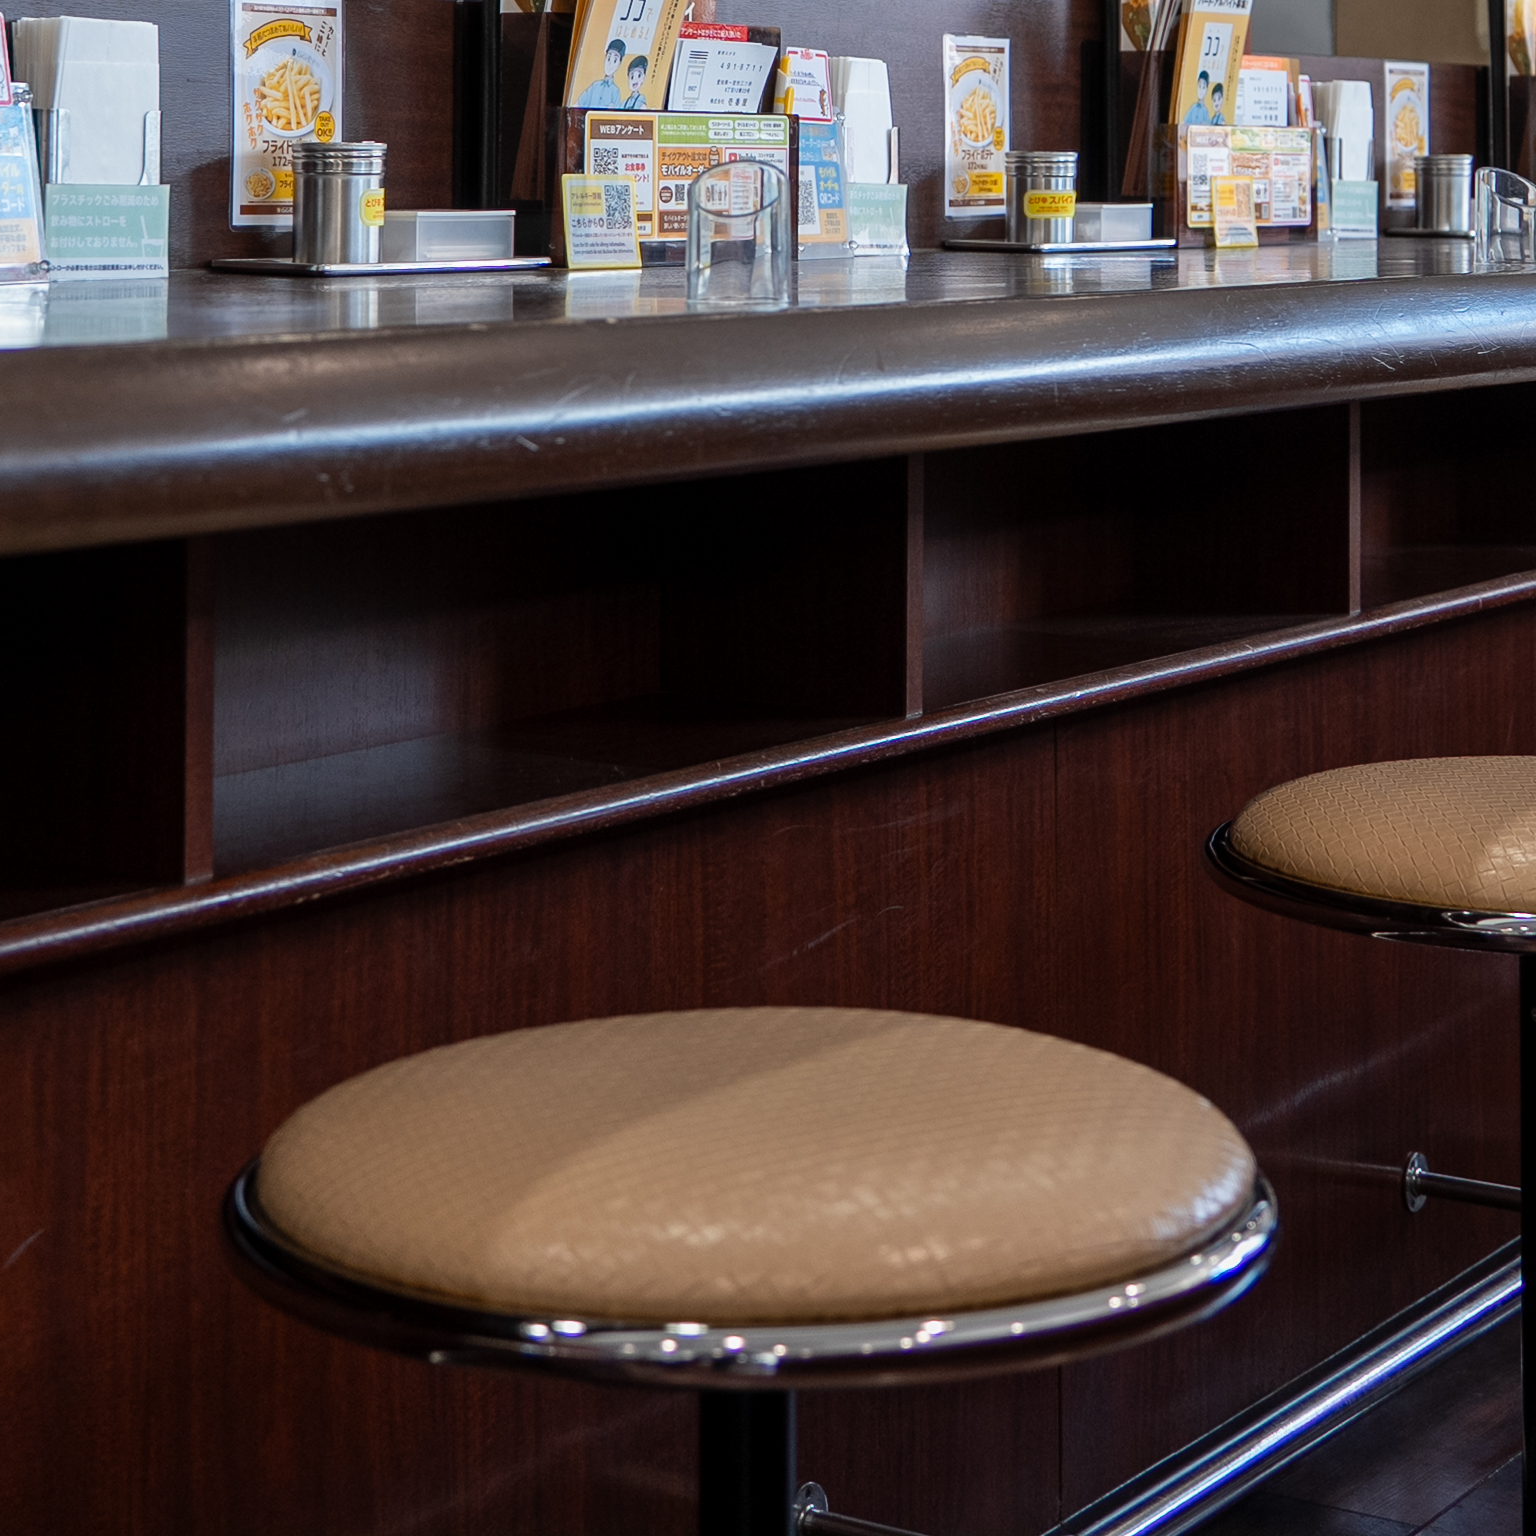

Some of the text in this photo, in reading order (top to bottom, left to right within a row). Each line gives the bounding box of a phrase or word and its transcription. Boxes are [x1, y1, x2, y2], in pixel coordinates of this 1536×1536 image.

[599, 124, 645, 135] WEBアンケート
[661, 152, 708, 161] テイクアウト注文は
[51, 194, 159, 207] プラスチックごみ削減のため
[1028, 196, 1073, 205] とび辛 スパイス
[50, 215, 127, 228] 飲み物にストローを
[571, 218, 599, 229] こちらから
[50, 236, 139, 249] お付けしておりません。
